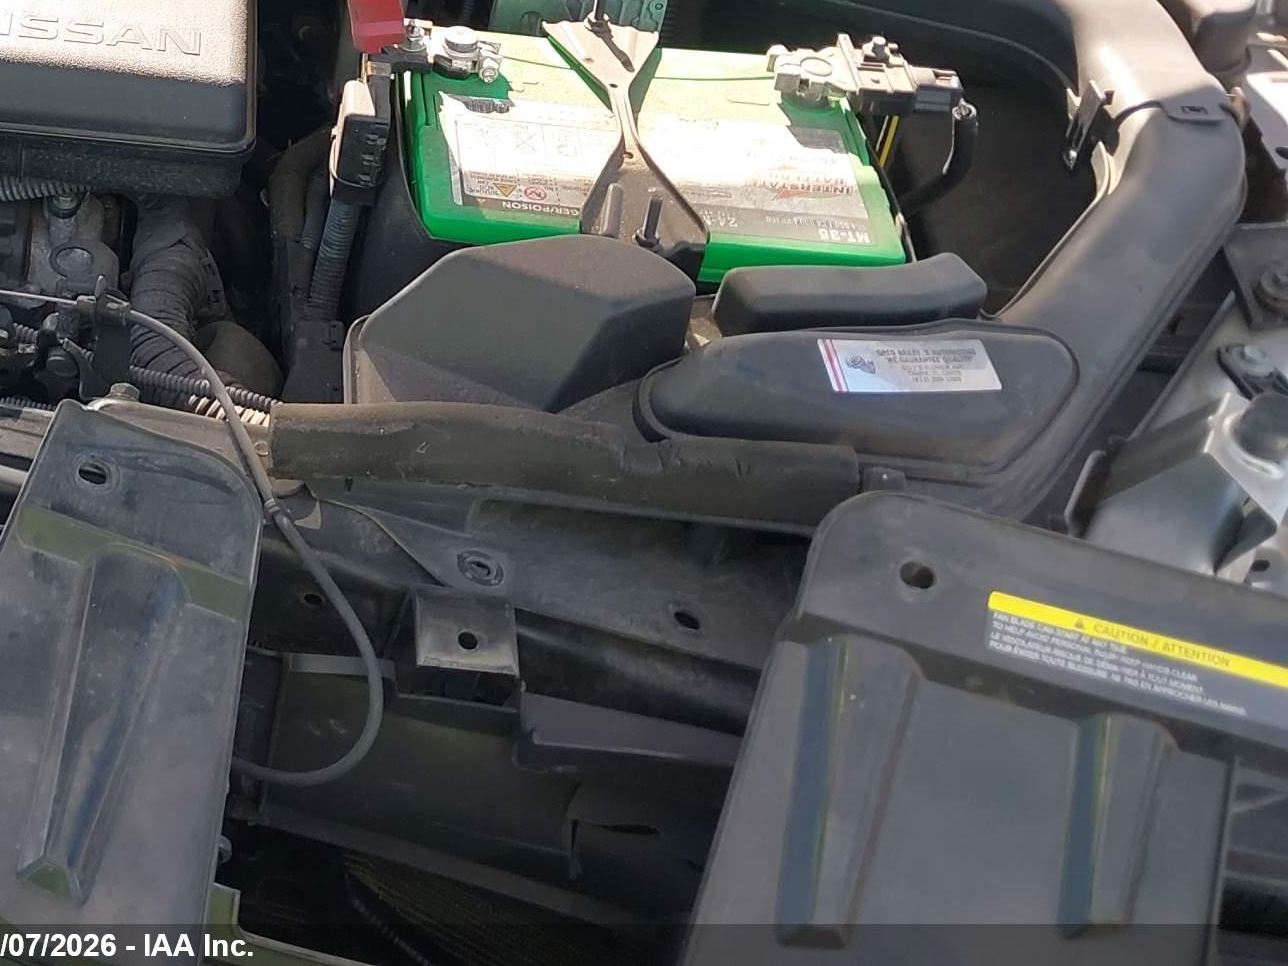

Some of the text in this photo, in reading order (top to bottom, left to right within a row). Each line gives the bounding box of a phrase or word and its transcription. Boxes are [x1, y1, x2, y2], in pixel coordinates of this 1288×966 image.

[501, 201, 580, 217] GER/POISON
[819, 227, 872, 244] MT-35
[1094, 624, 1148, 646] CAUTION
[1161, 641, 1230, 667] ATTENTION
